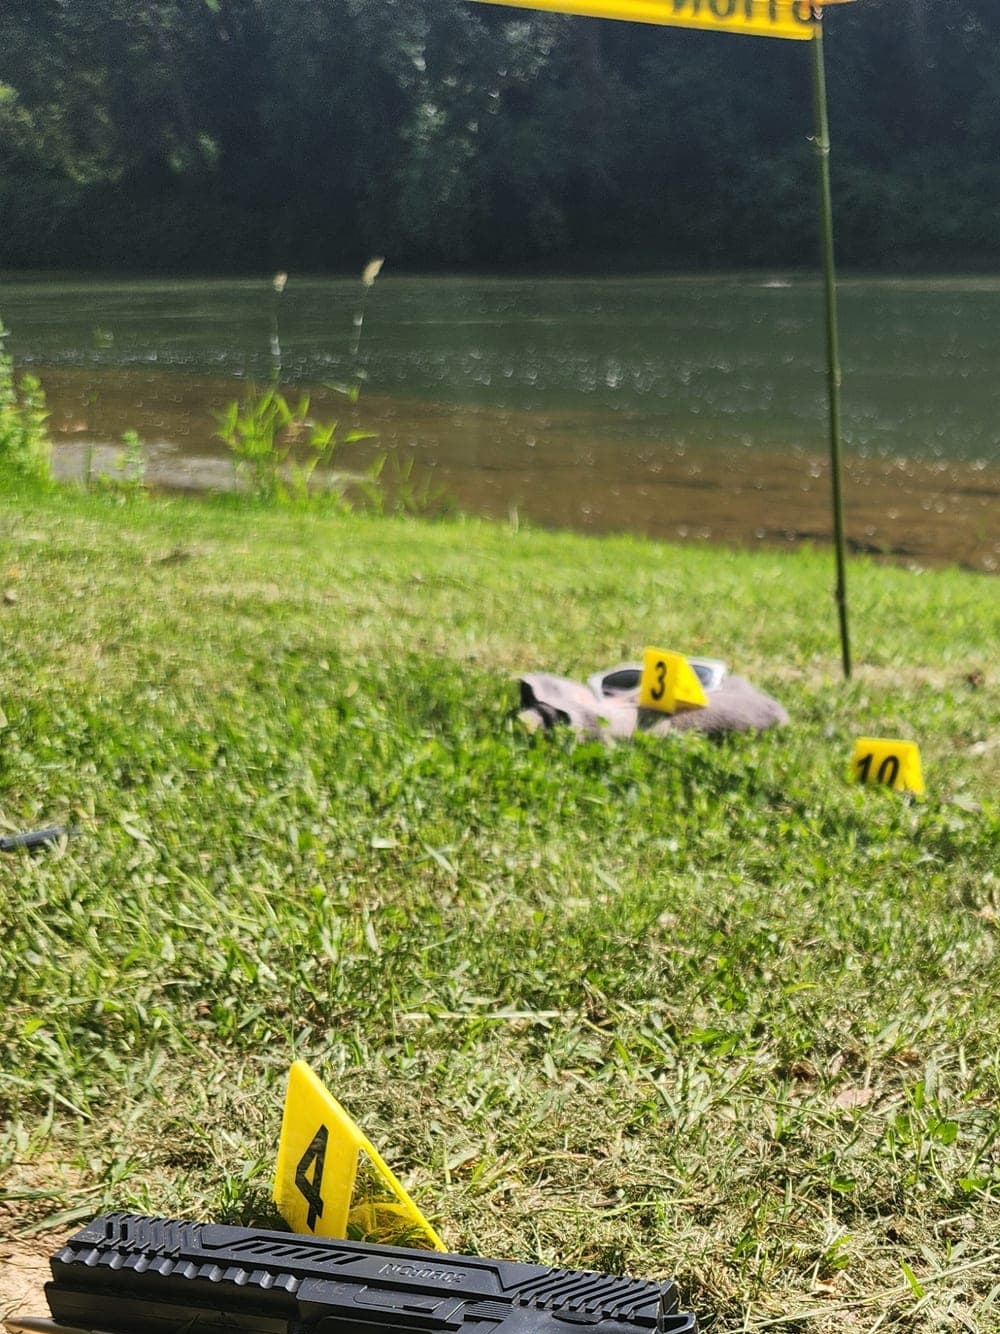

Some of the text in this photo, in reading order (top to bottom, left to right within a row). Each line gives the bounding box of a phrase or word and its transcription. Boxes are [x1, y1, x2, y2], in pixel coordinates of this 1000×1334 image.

[650, 661, 667, 700] 3
[857, 753, 900, 788] 10
[295, 1124, 329, 1232] 4
